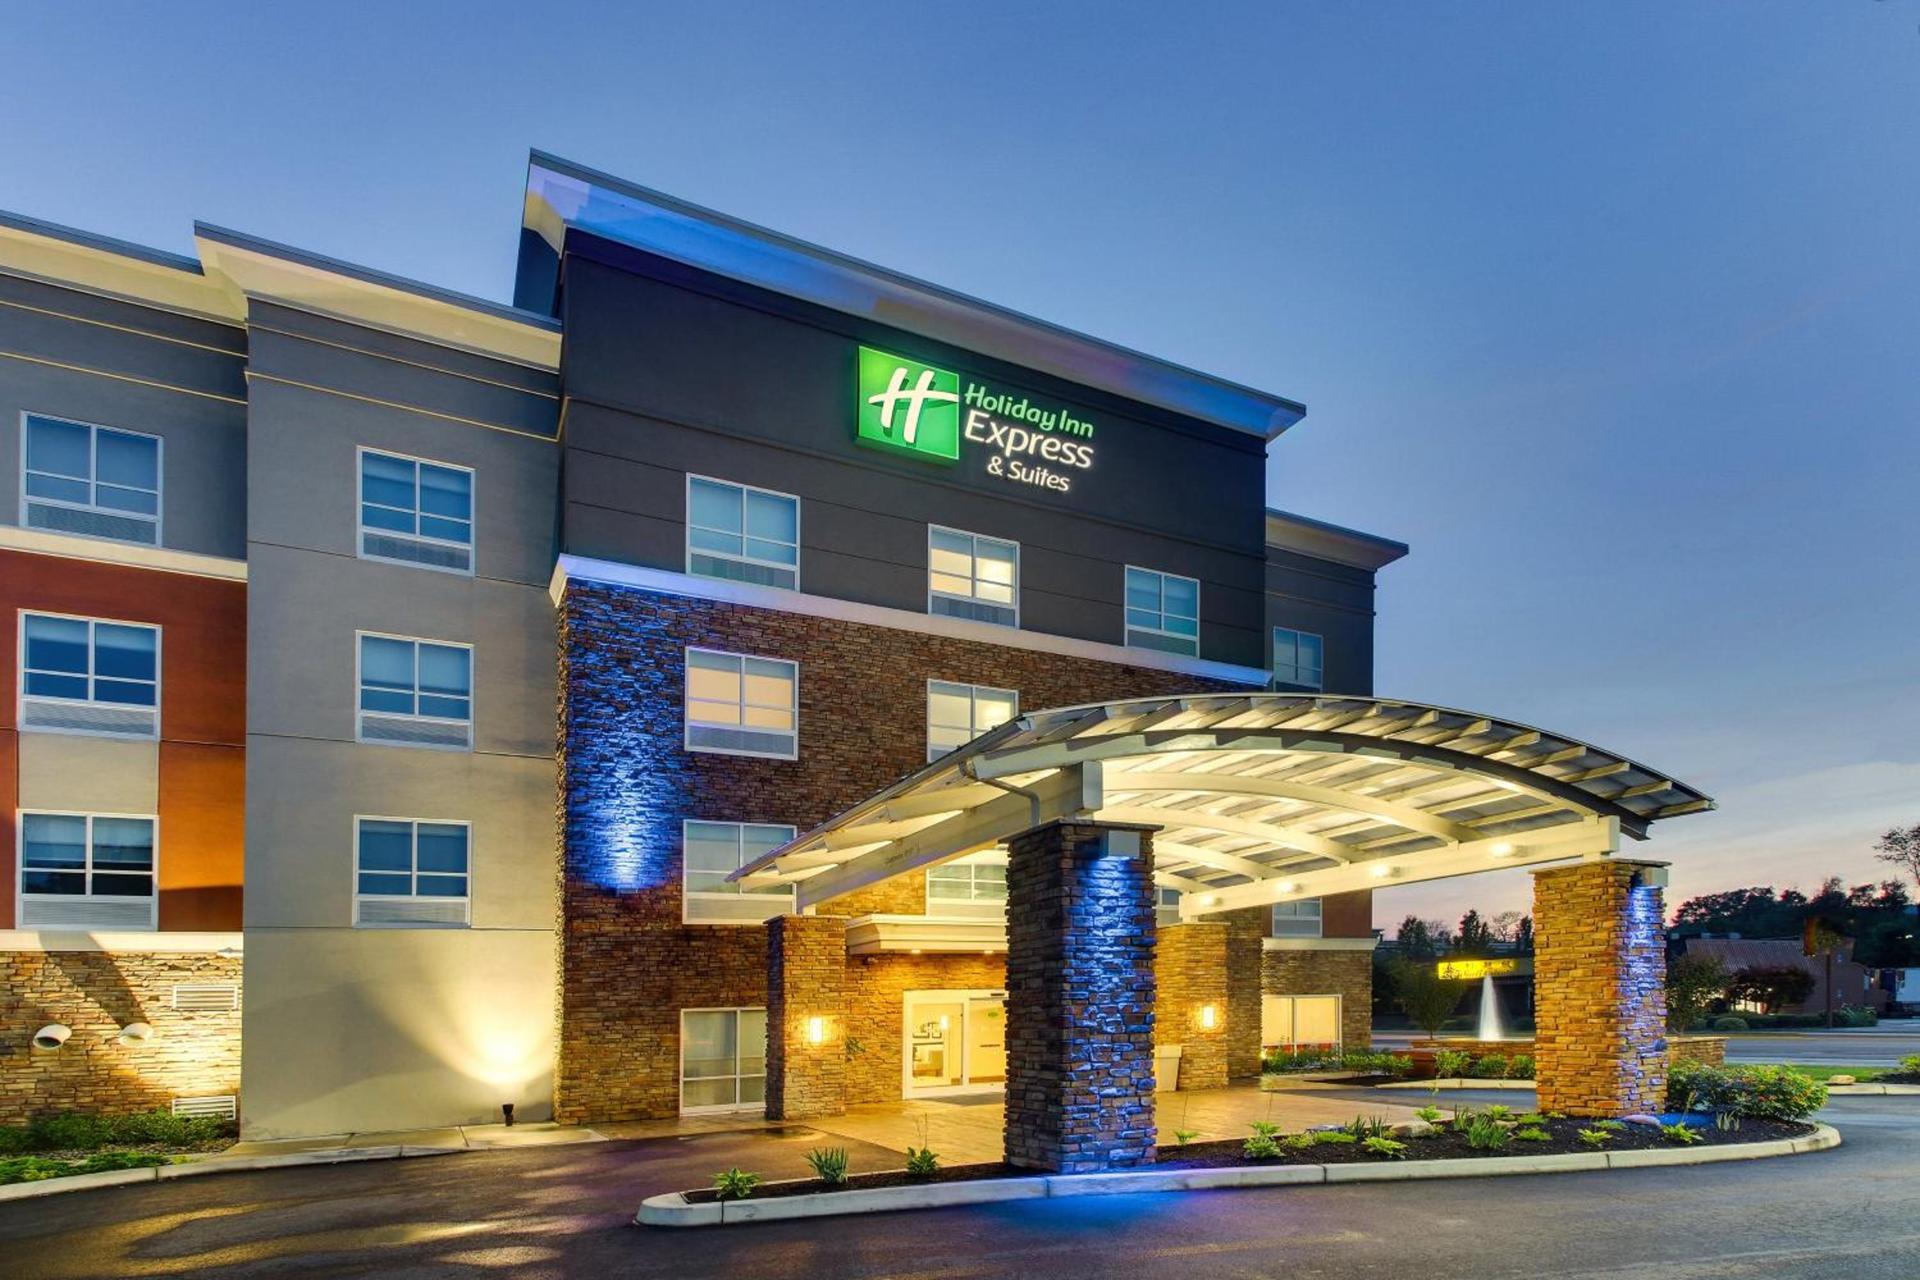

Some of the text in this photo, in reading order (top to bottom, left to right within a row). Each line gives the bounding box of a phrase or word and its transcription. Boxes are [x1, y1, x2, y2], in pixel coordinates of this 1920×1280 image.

[965, 384, 1094, 438] Holiday Inn
[965, 410, 1094, 469] Express
[987, 456, 1070, 491] & Suites
